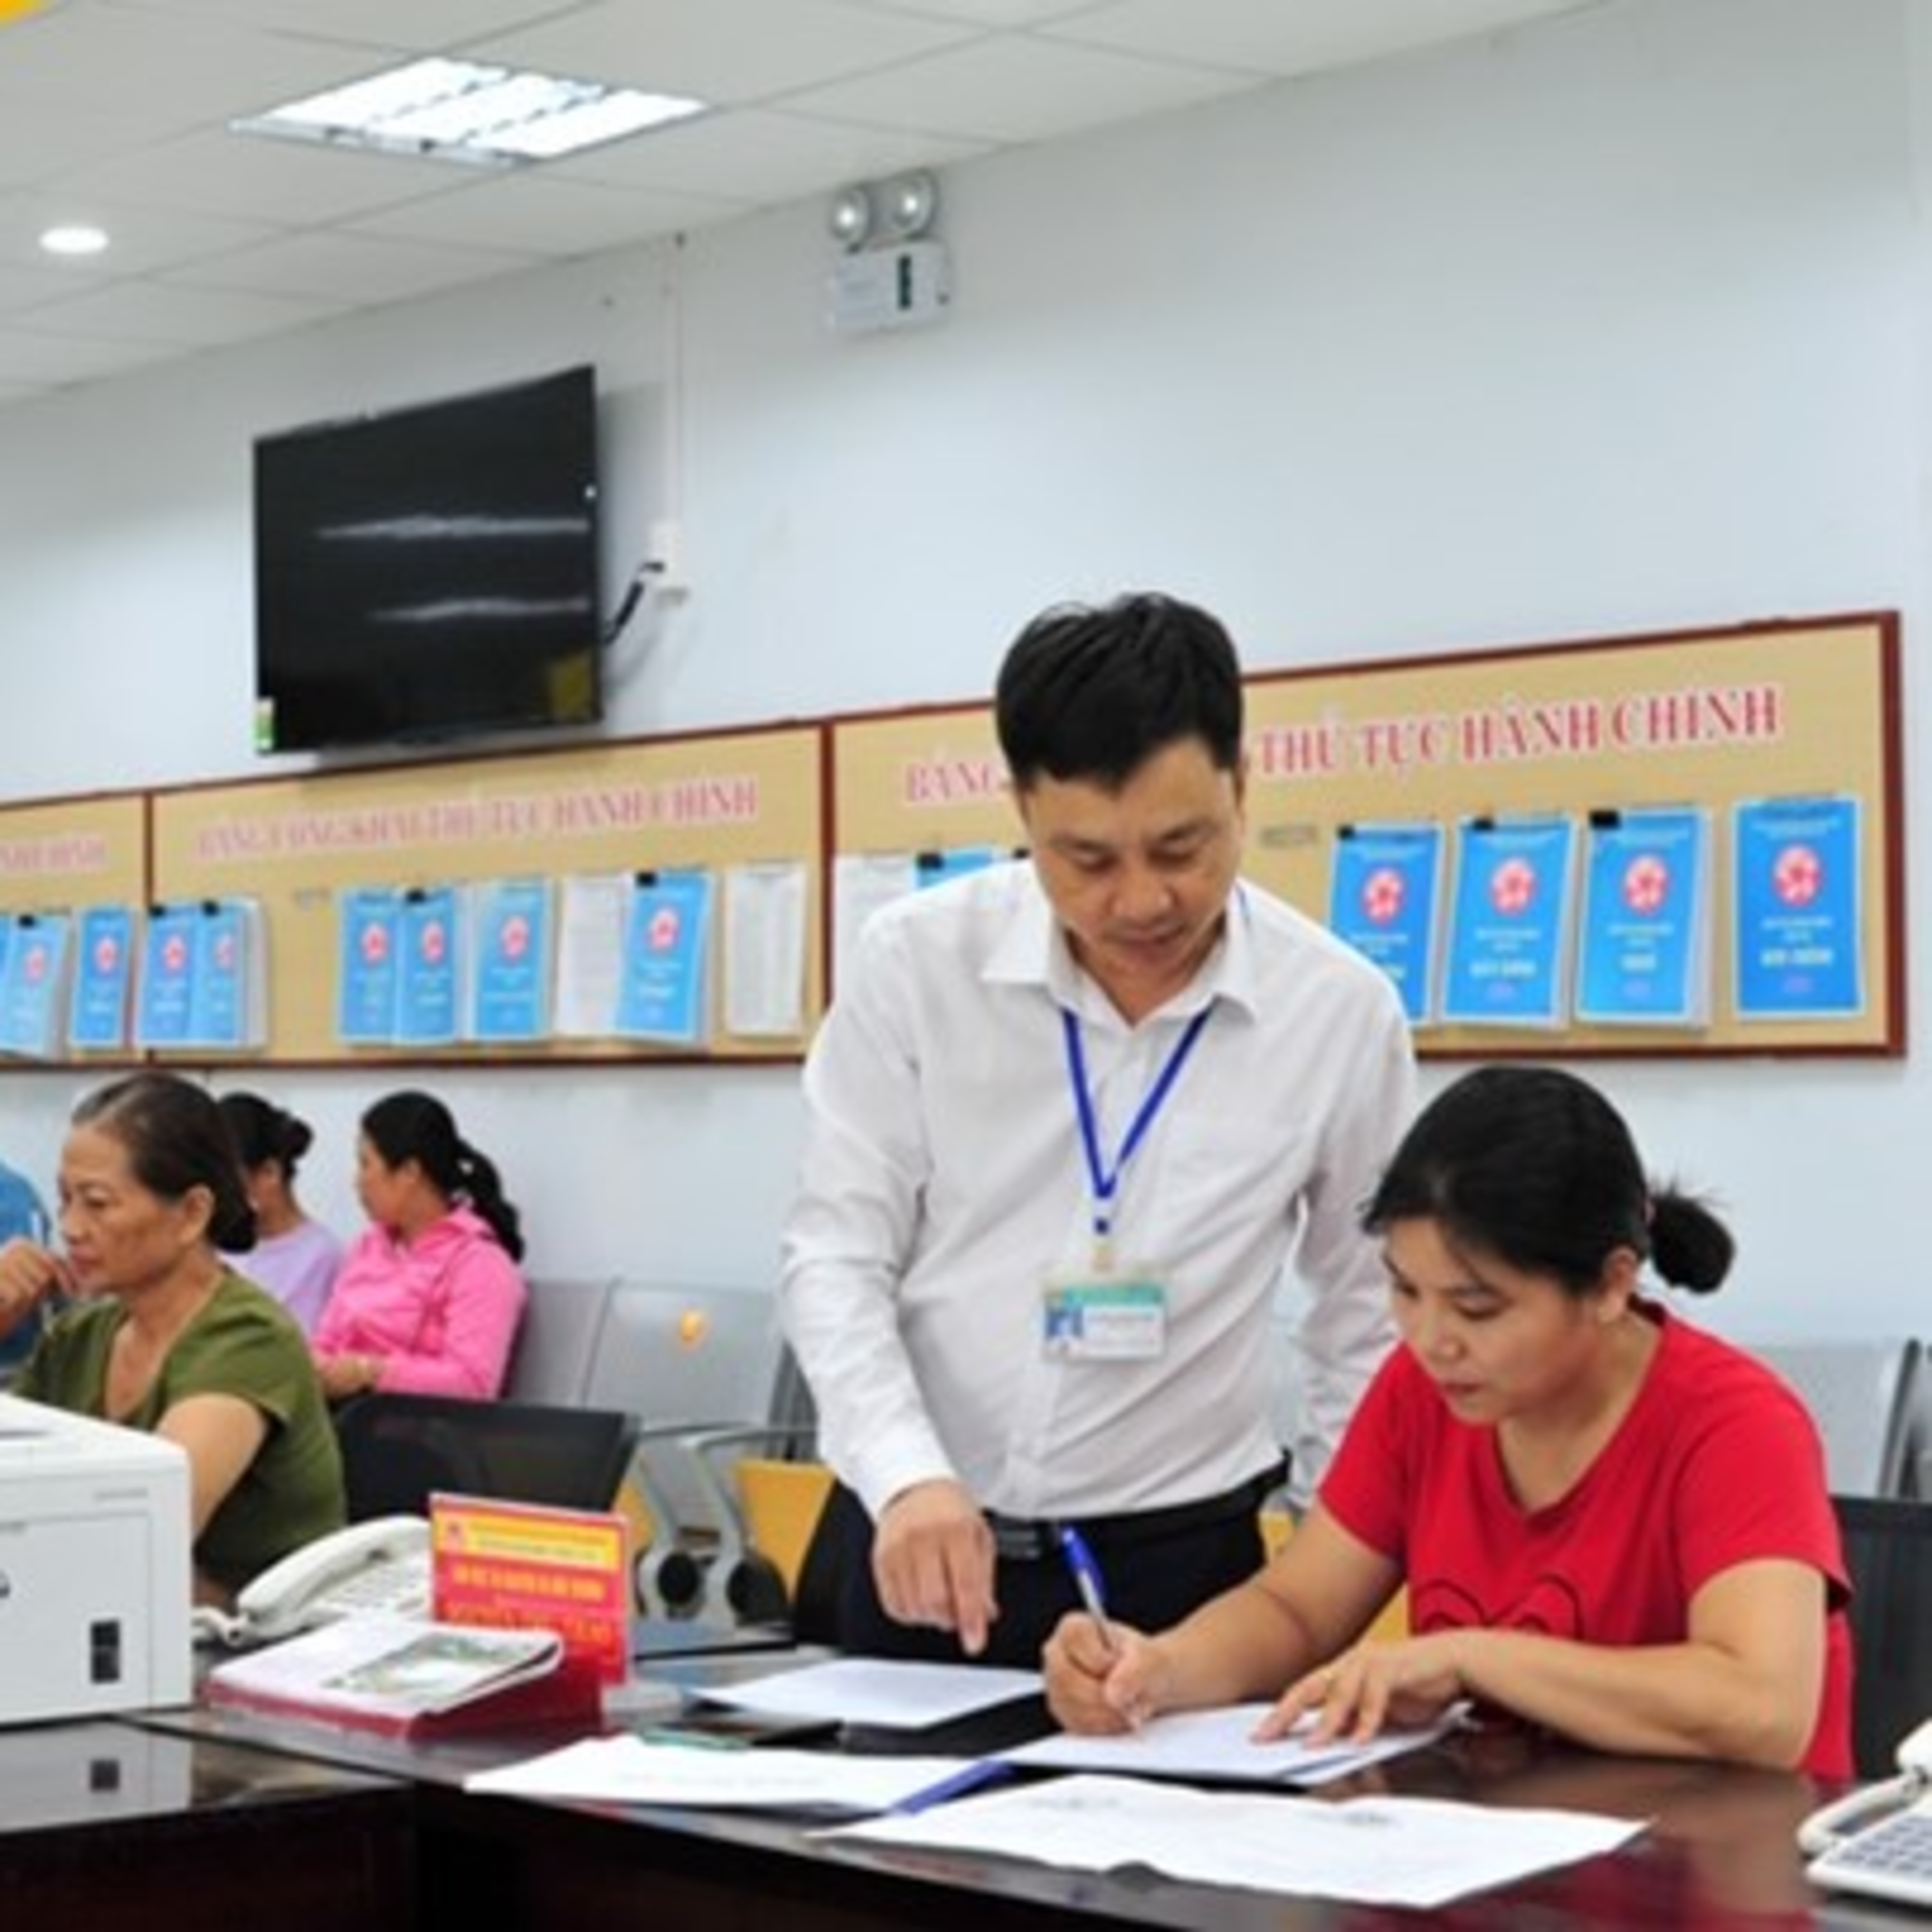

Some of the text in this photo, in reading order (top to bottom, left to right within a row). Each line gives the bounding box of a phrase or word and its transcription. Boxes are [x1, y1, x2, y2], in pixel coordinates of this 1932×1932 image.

[1261, 703, 1347, 775] THỦ
[1359, 717, 1449, 781] TỤC
[1461, 690, 1601, 762] HÀNH
[1610, 681, 1780, 746] CHÍNH
